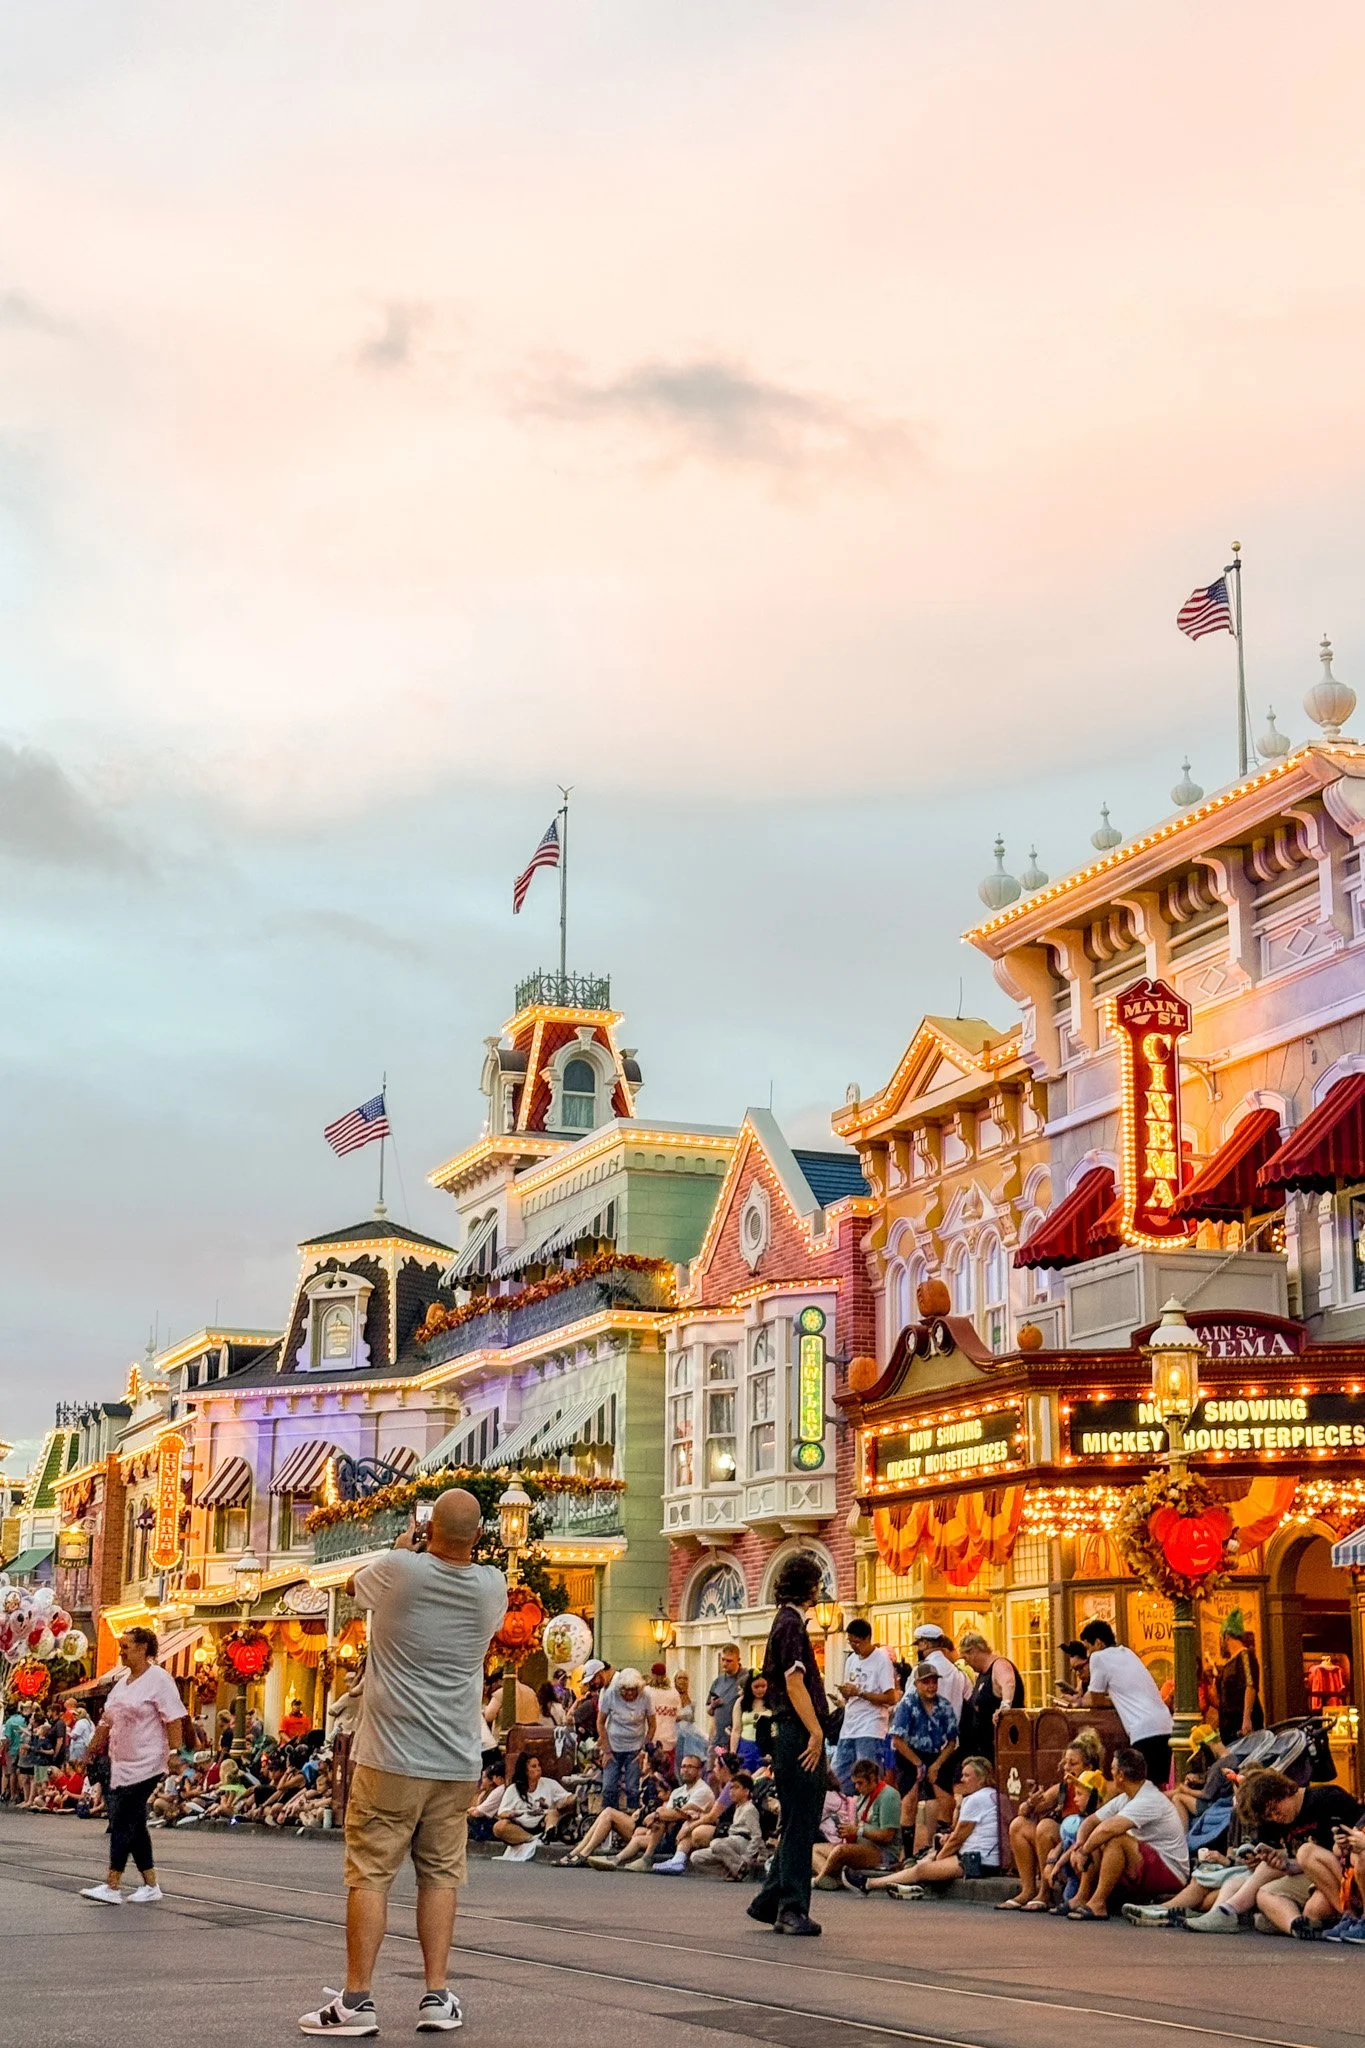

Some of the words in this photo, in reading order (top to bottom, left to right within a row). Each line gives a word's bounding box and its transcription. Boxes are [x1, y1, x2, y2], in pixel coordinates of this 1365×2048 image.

[1123, 1000, 1179, 1018] MAIN
[1157, 1012, 1186, 1027] ST.
[1143, 1033, 1177, 1208] CINEMA
[804, 1339, 819, 1437] JEWELRY
[1204, 1399, 1307, 1422] SHOWING
[910, 1430, 932, 1452] NOW
[937, 1419, 982, 1447] SHOWING
[1082, 1431, 1164, 1453] MICKEY
[887, 1457, 922, 1481] MICKEY
[925, 1440, 1008, 1475] MOUSETERPIECES
[163, 1452, 177, 1509] CRYSTAL
[160, 1517, 173, 1550] ARTS
